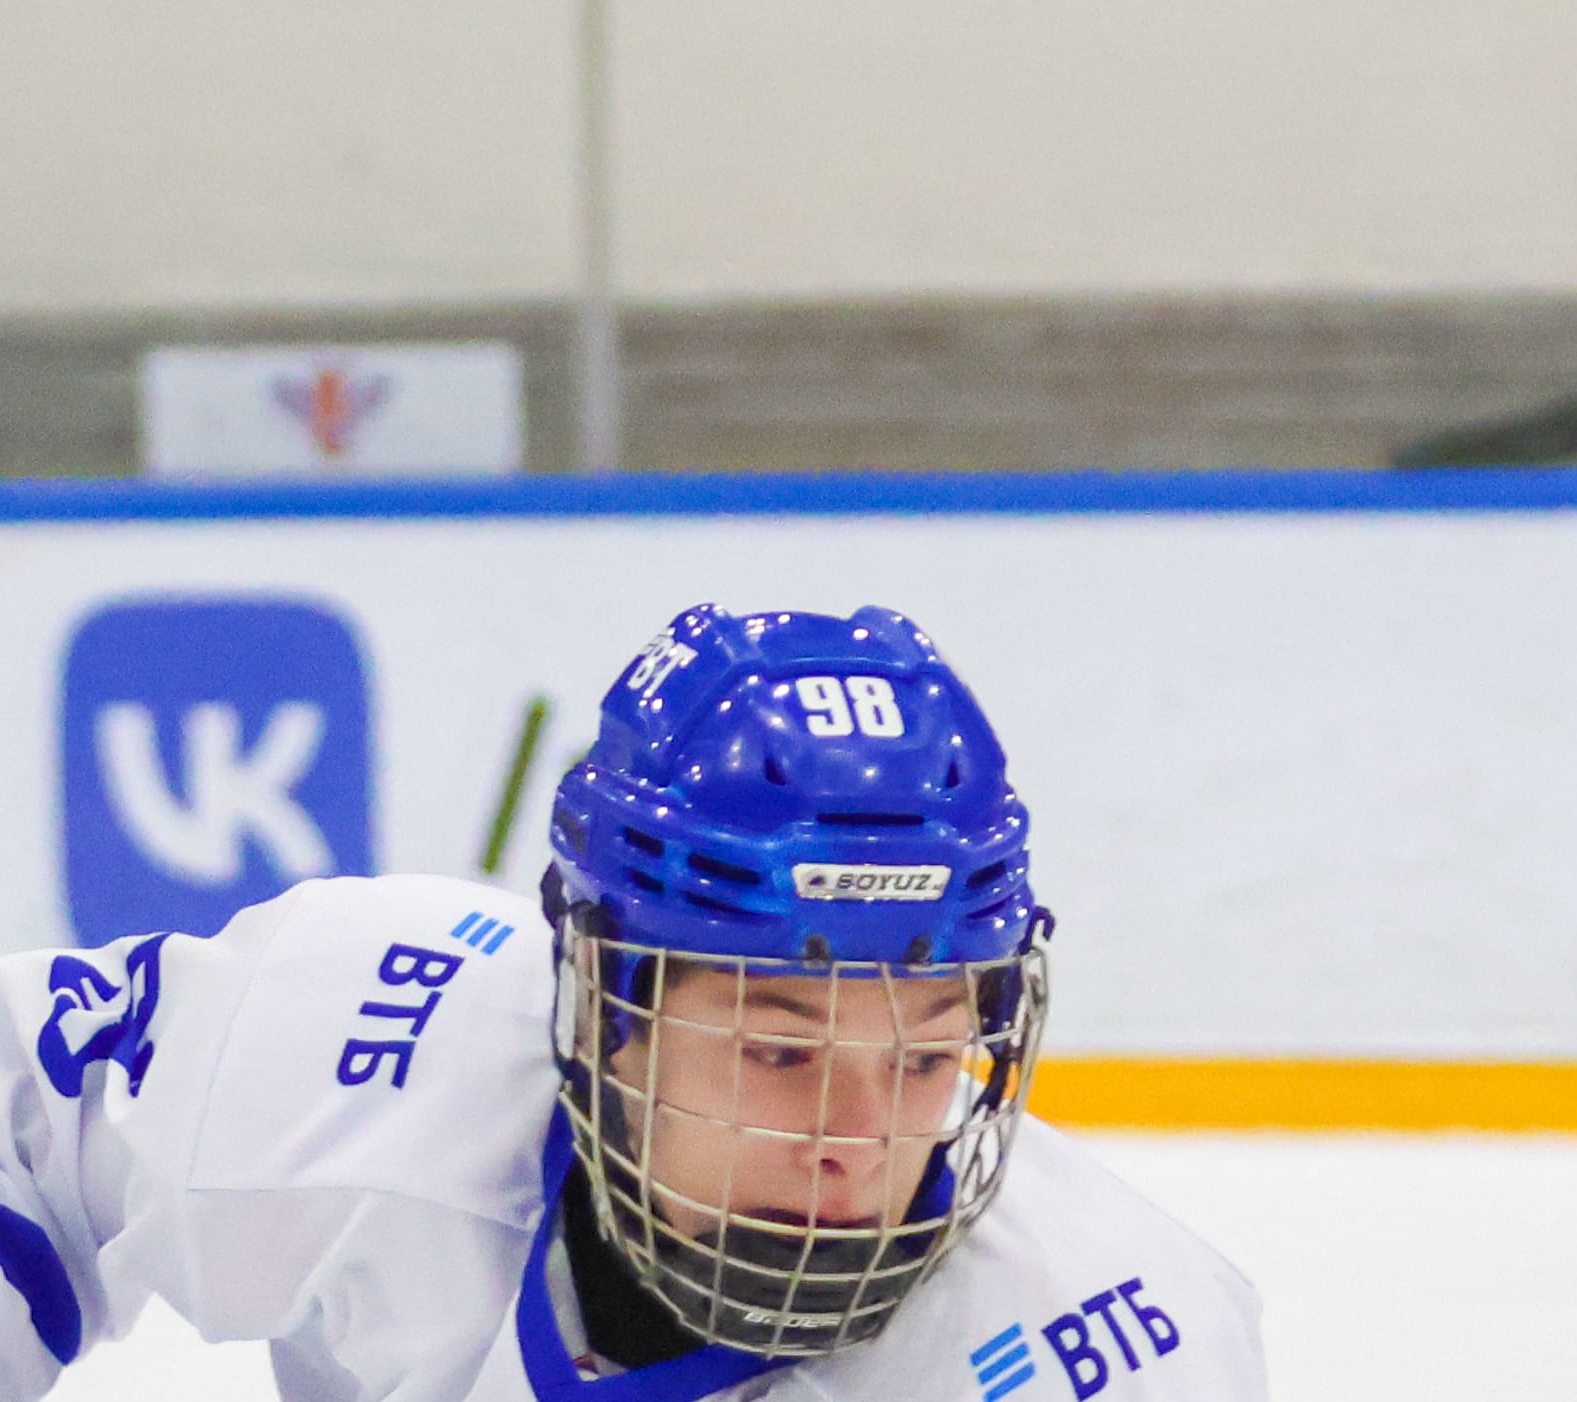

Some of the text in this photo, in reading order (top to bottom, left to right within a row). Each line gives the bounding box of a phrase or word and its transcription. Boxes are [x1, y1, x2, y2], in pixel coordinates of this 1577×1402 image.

[794, 676, 906, 738] 98
[99, 702, 337, 886] VK
[834, 872, 933, 892] SOYUZ
[336, 942, 465, 1090] ВТБ
